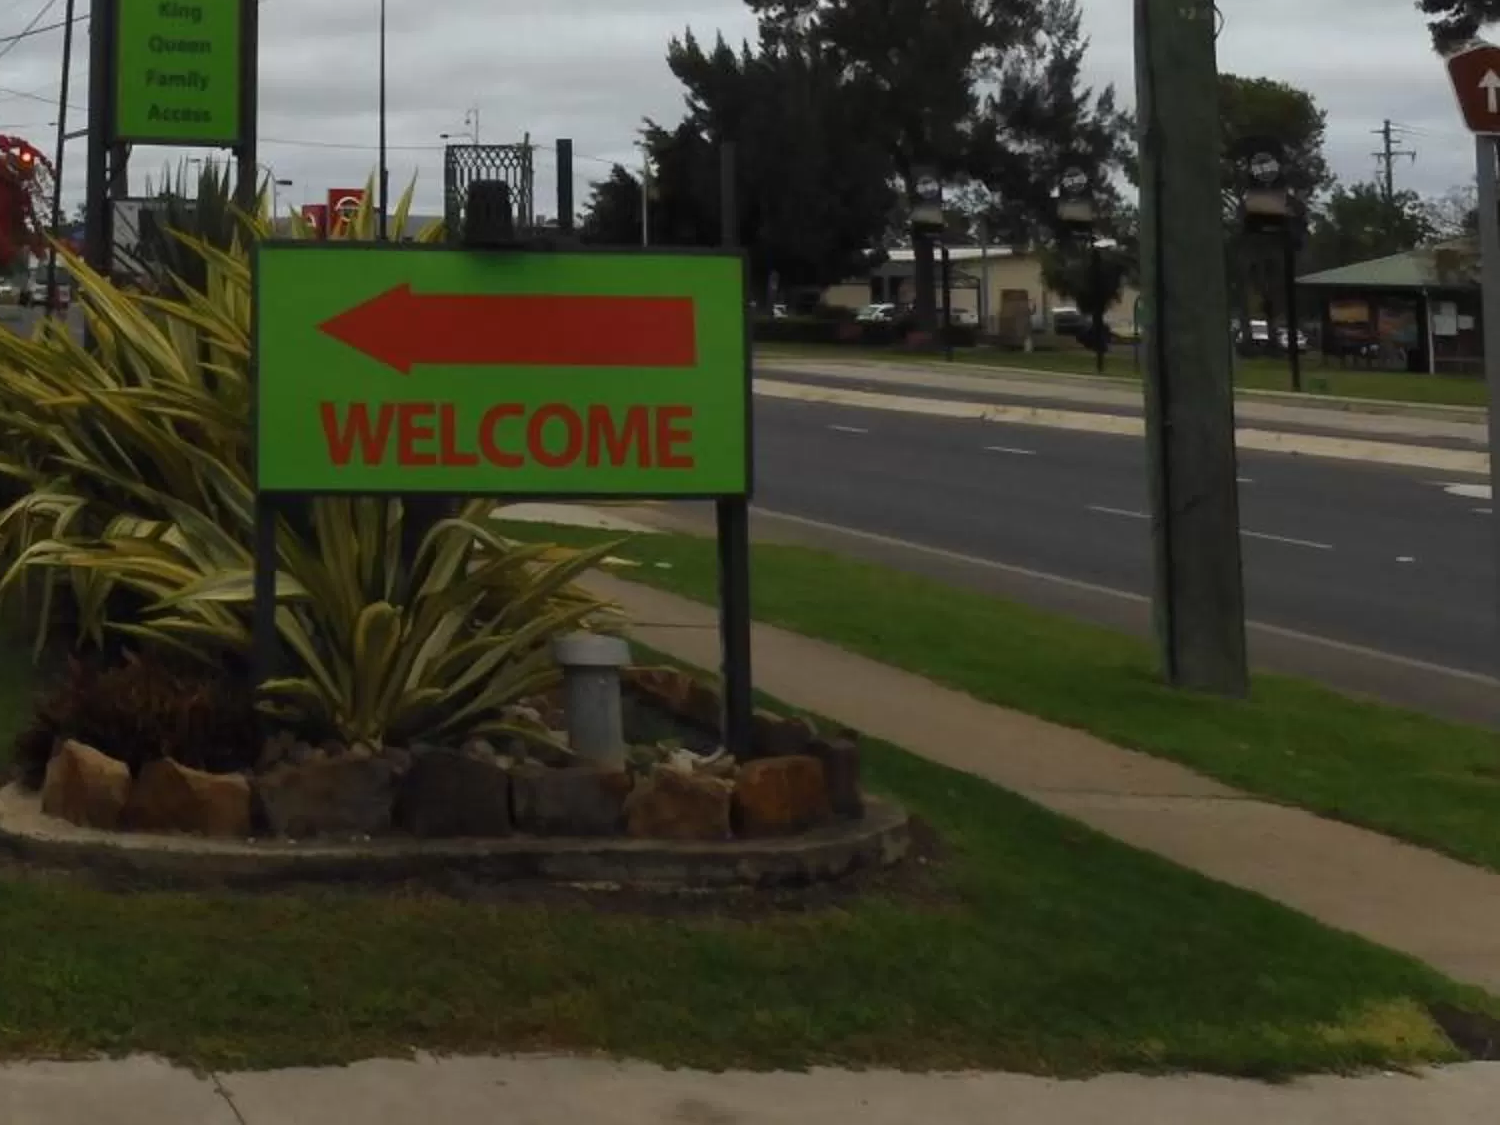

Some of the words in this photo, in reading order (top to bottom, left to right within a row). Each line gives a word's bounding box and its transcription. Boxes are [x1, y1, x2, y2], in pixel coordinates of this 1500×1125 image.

[159, 1, 202, 24] King
[148, 34, 212, 54] Queen
[145, 68, 209, 92] Family
[148, 103, 212, 123] Access
[319, 400, 695, 470] WELCOME
